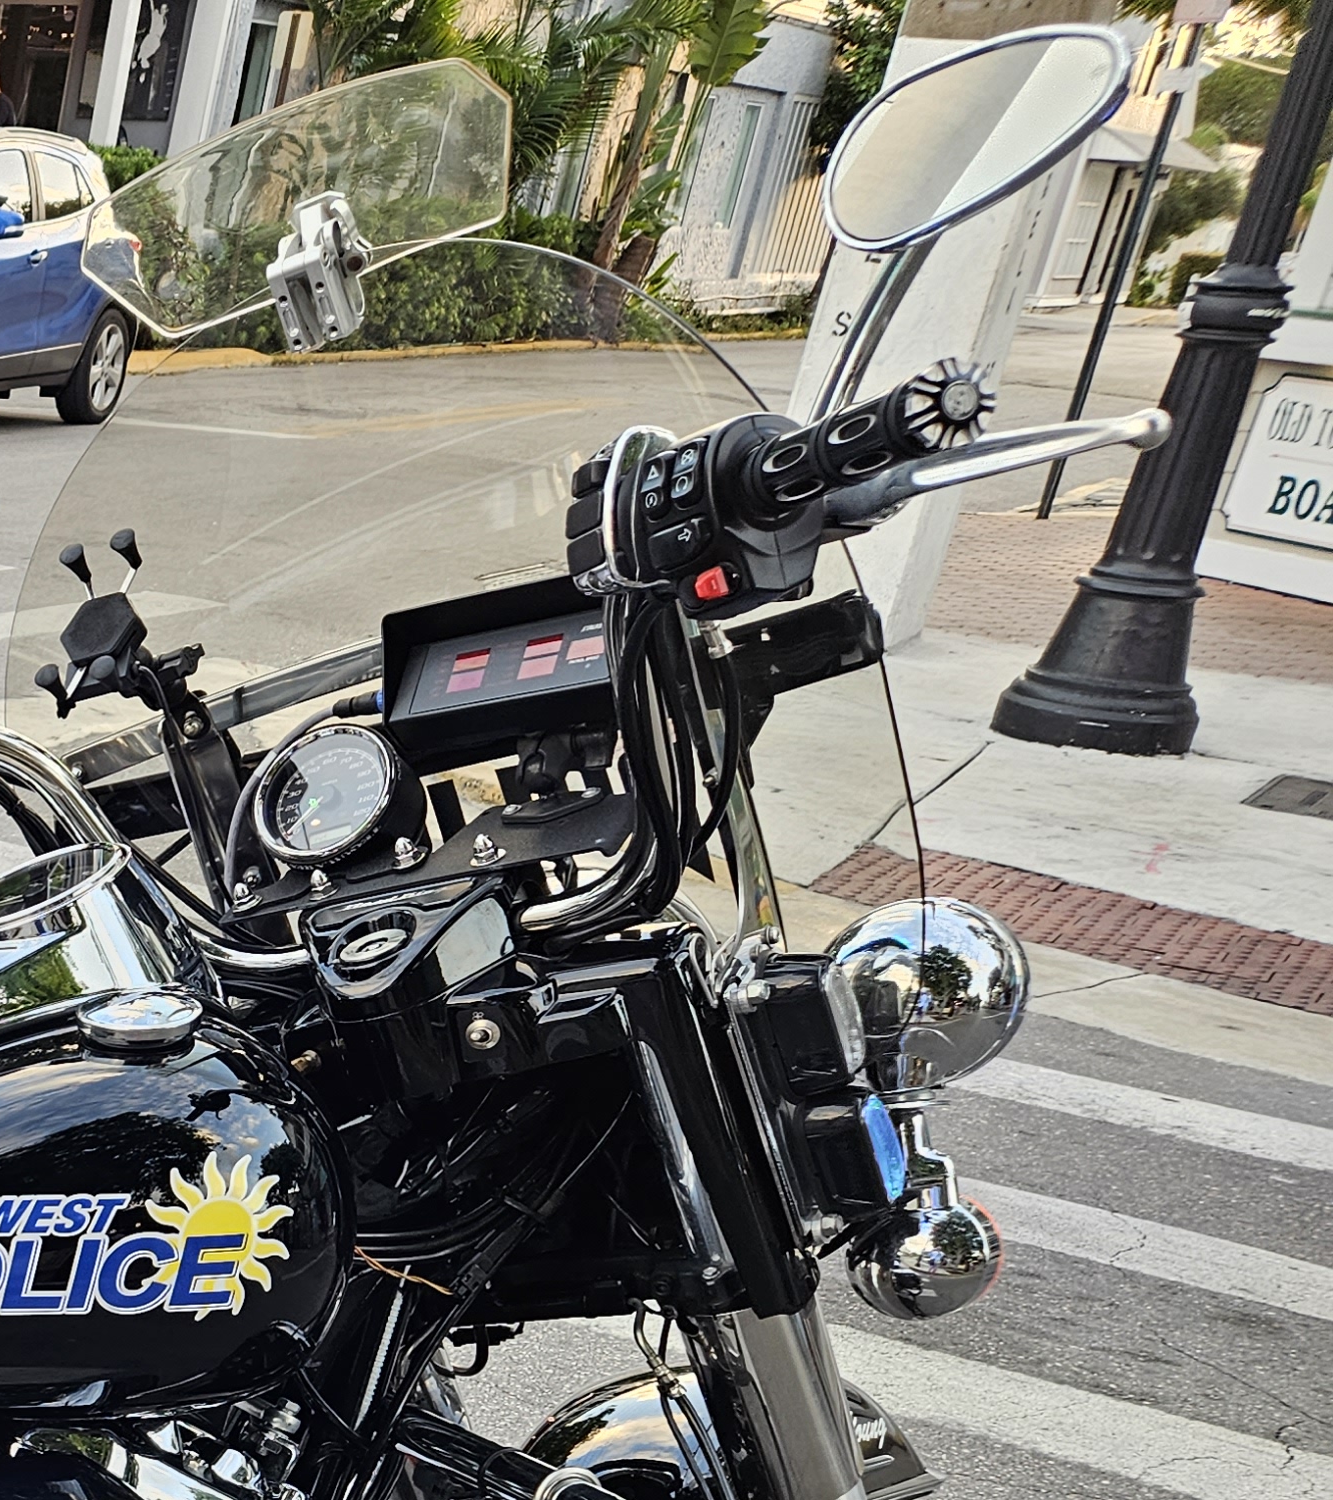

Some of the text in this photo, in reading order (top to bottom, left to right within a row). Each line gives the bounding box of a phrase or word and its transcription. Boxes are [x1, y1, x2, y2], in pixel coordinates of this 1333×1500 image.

[1267, 398, 1313, 444] OLD
[294, 777, 308, 785] 40
[287, 790, 302, 798] 30
[285, 804, 299, 812] 20
[286, 816, 299, 825] 10
